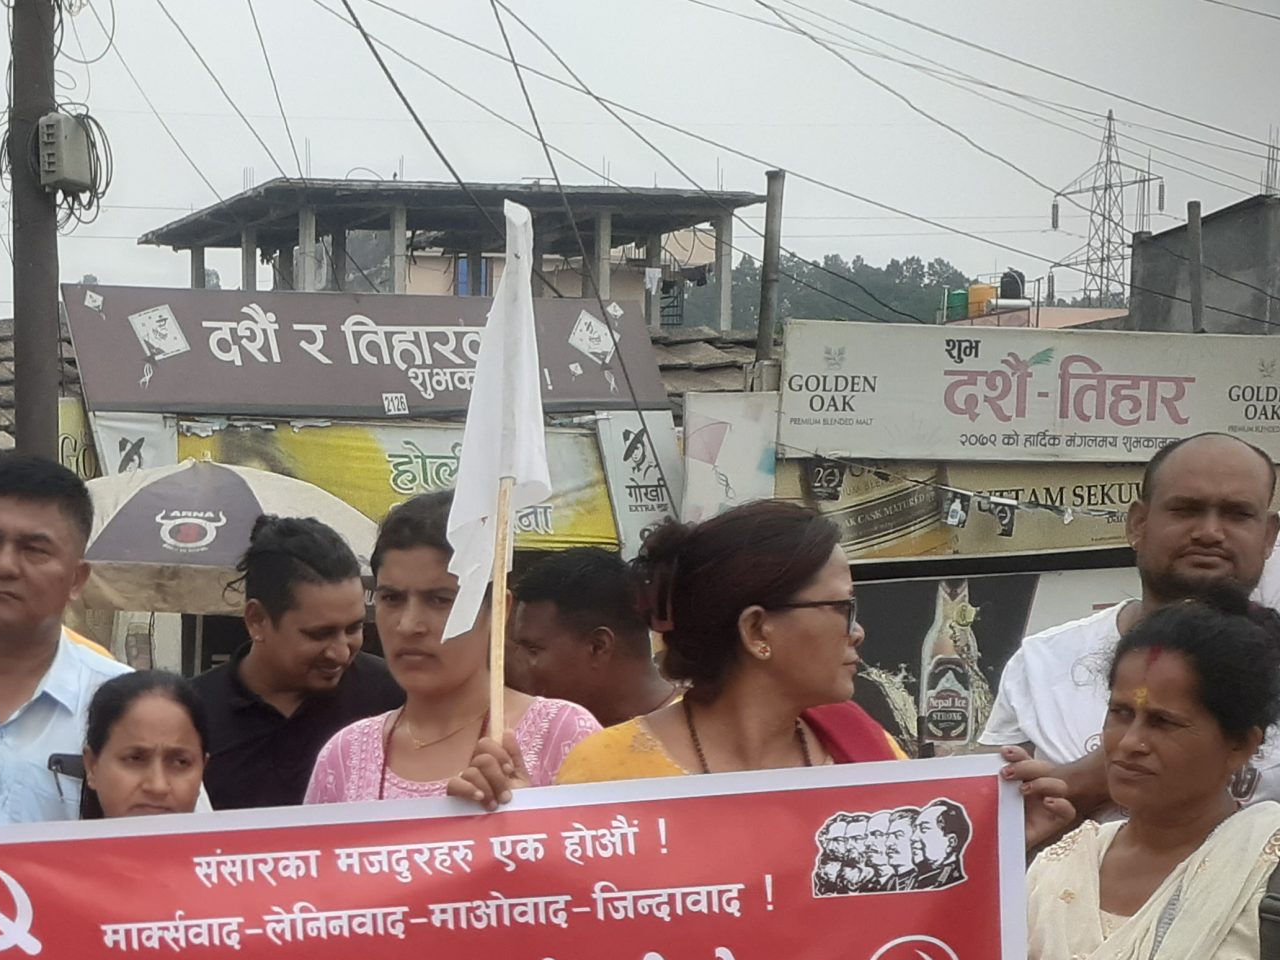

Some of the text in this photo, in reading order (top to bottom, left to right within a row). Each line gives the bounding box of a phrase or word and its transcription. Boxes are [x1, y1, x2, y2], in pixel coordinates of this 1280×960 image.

[201, 303, 282, 366] दशैं
[292, 324, 333, 364] र
[945, 339, 981, 364] शुभ
[788, 374, 877, 393] GOLDEN
[384, 395, 407, 412] 2126
[809, 394, 855, 412] OAK
[1245, 404, 1280, 420] OAK
[822, 418, 854, 426] BLENDED
[856, 418, 873, 426] MALT
[1002, 430, 1020, 447] को
[1024, 430, 1062, 448] हार्दिक
[1065, 434, 1118, 448] मंगलमय
[170, 510, 215, 518] ARNA
[192, 848, 322, 889] संसारका
[334, 838, 476, 884] मजदुरहरु
[488, 832, 549, 872] एक
